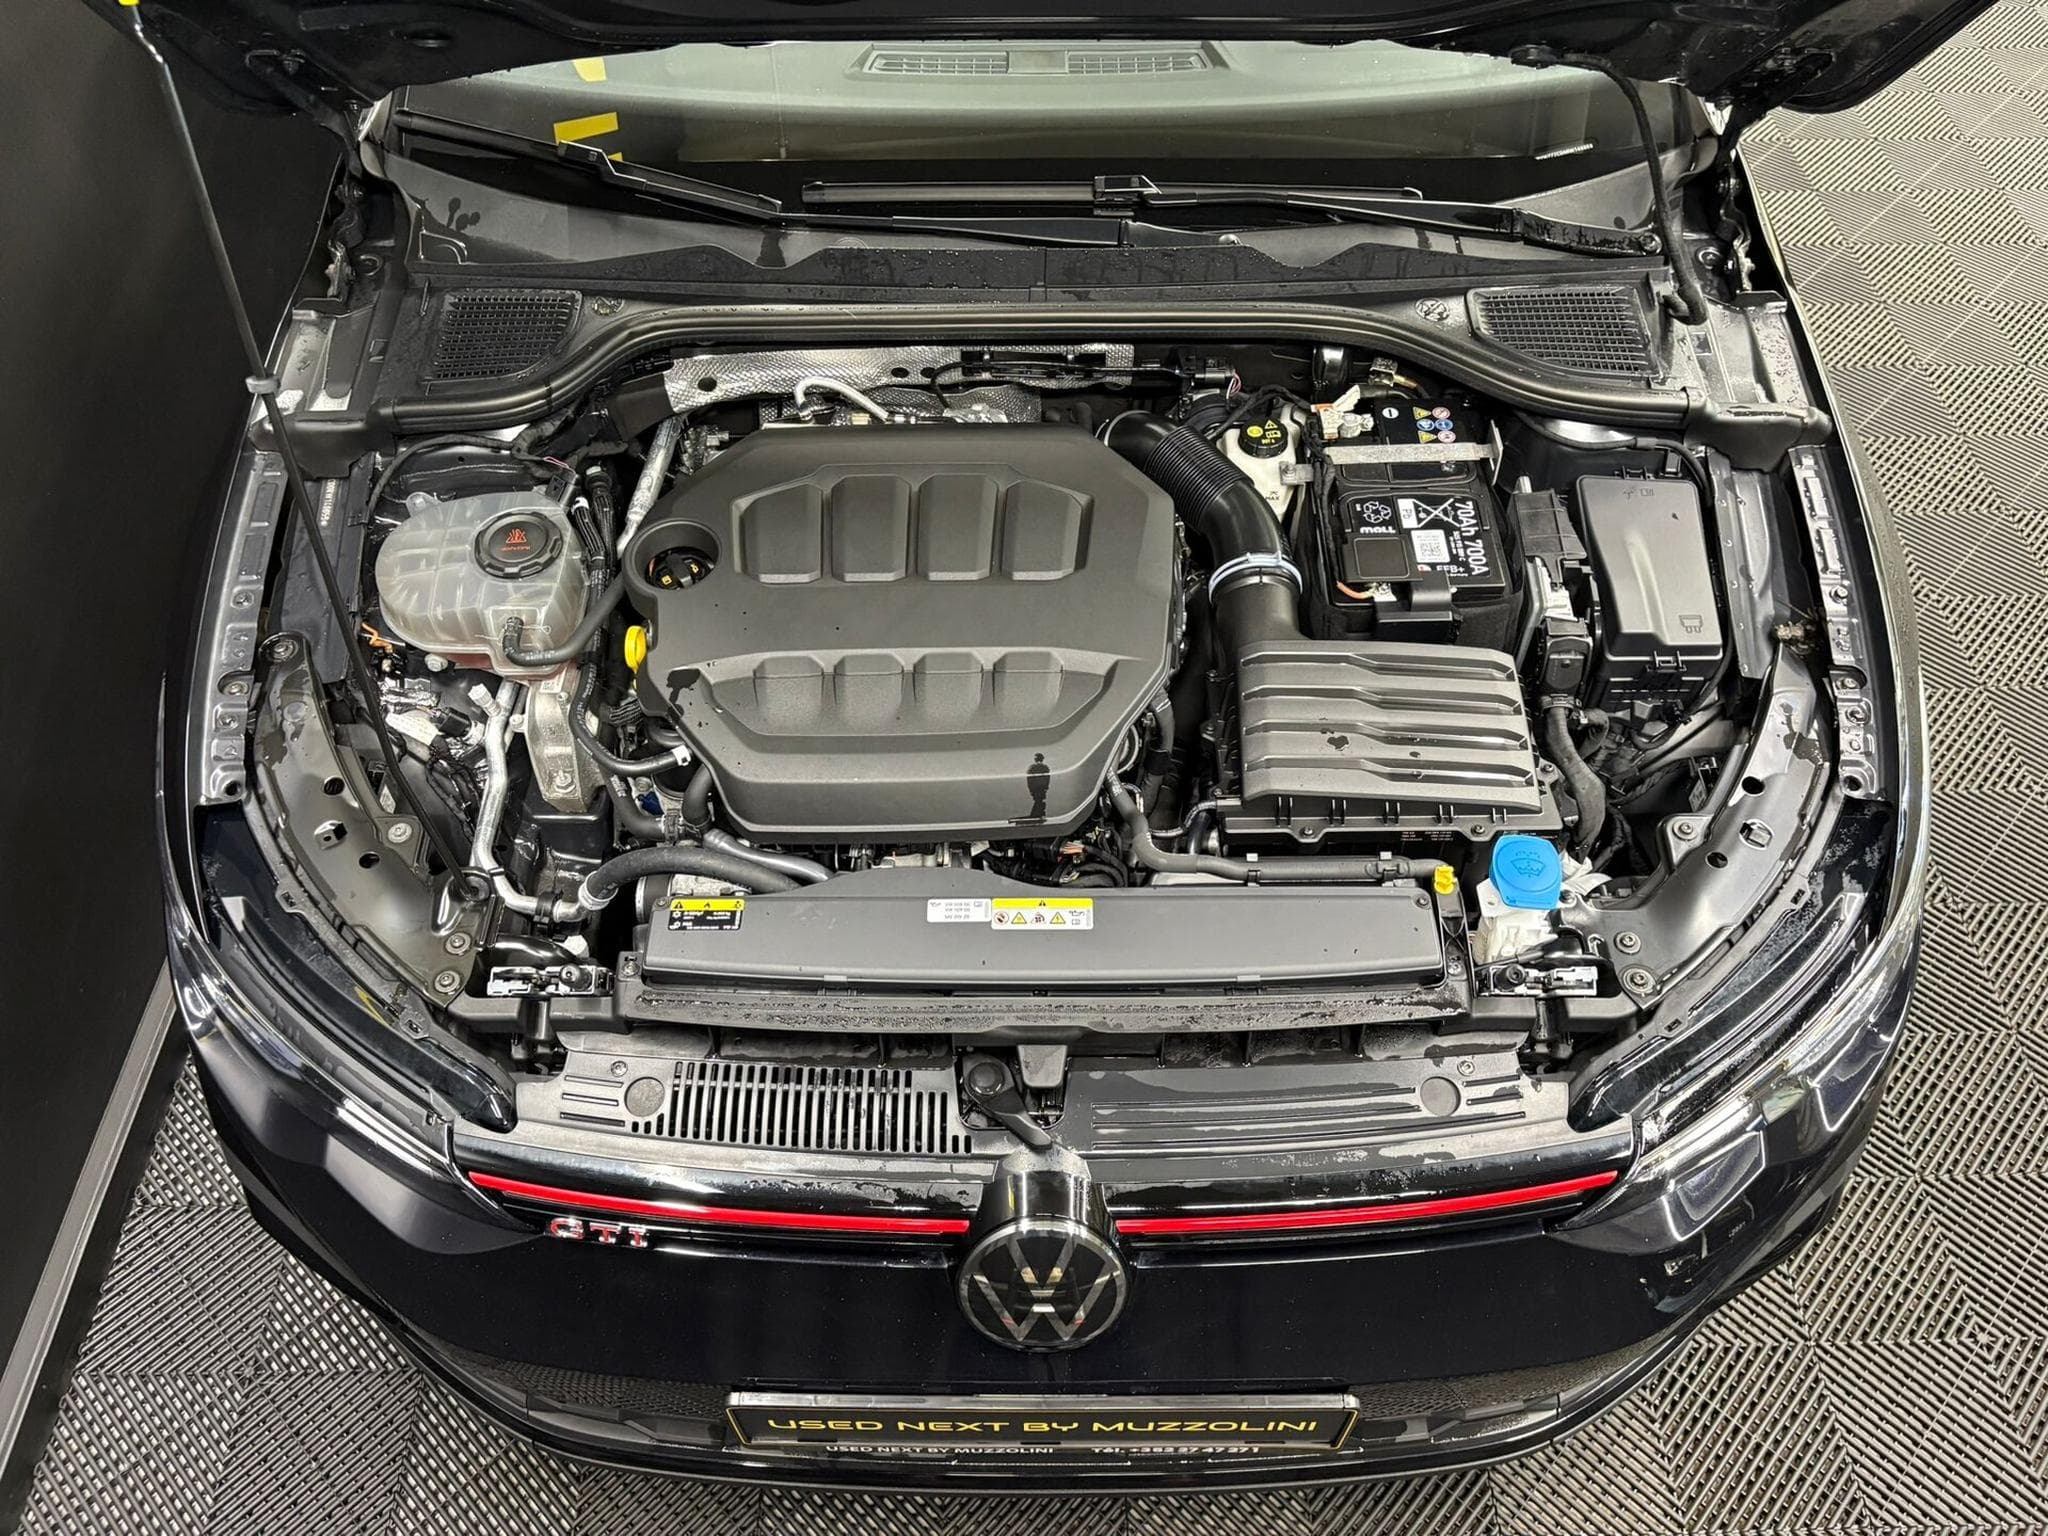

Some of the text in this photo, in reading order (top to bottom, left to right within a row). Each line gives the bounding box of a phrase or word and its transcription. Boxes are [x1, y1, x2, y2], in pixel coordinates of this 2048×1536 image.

[1454, 501, 1479, 537] 70Ah
[1464, 539, 1490, 576] 700A
[549, 1216, 649, 1248] GTI
[767, 1419, 1318, 1432] USED NEXT BY MUZZOLINI
[826, 1445, 873, 1453] USED
[927, 1446, 950, 1454] BY
[954, 1446, 1054, 1454] MUZZOLINI
